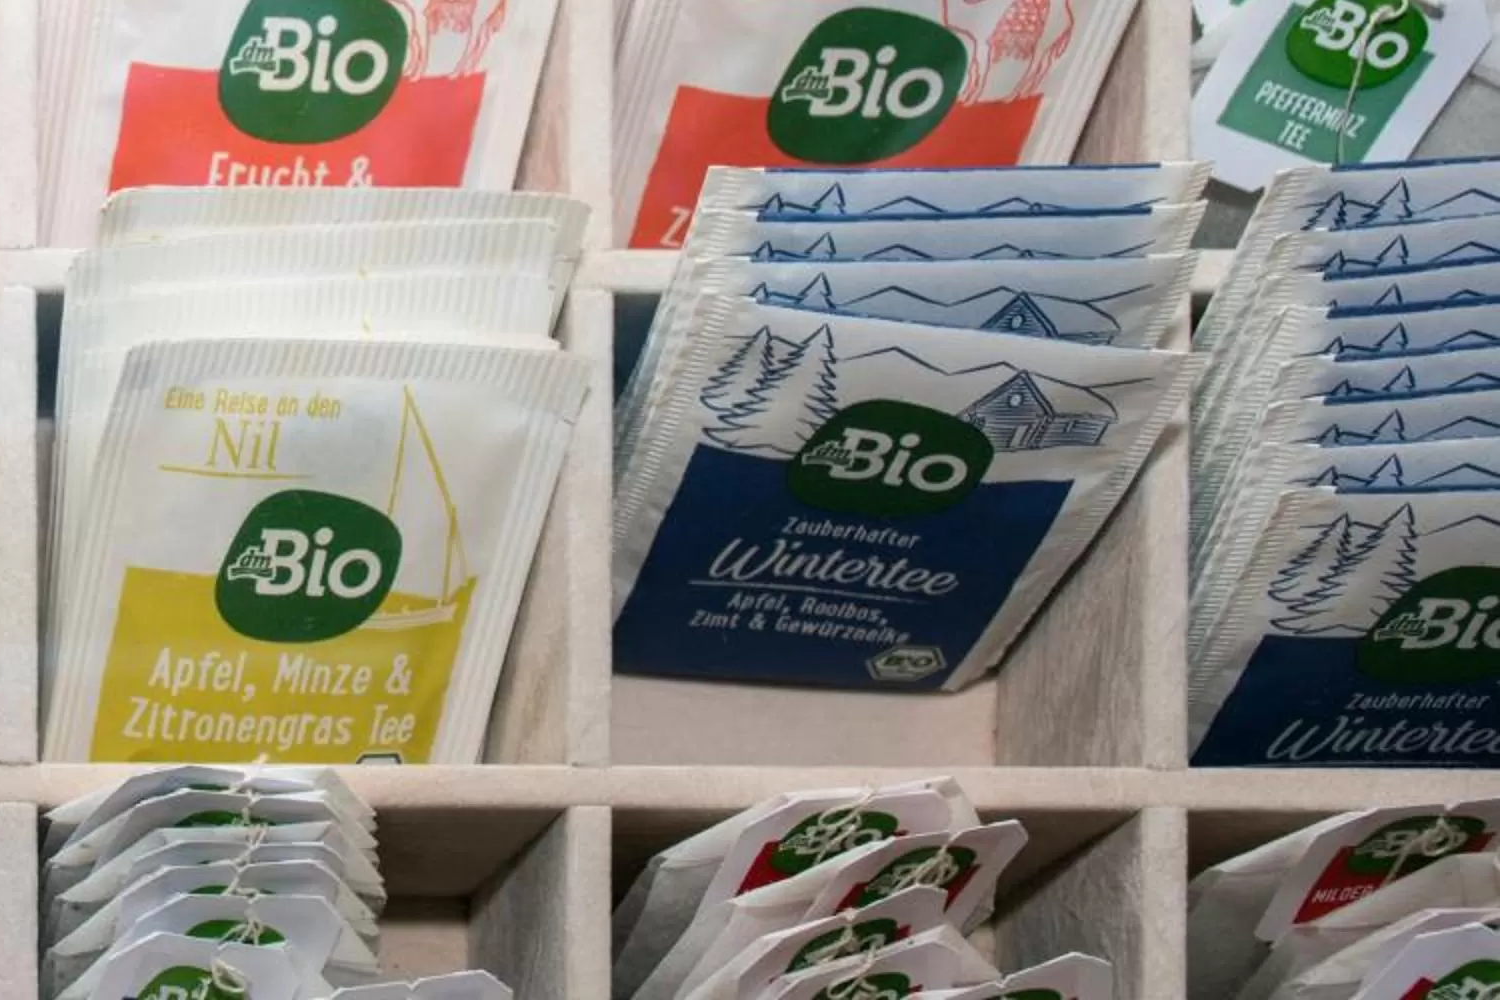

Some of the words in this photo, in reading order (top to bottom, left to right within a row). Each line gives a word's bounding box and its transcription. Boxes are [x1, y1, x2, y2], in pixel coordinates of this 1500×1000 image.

[260, 15, 389, 95] Bio
[809, 45, 943, 118] Bio
[1278, 120, 1312, 150] TEE
[207, 151, 330, 188] Frucht
[350, 155, 373, 188] &
[164, 385, 204, 411] Eine
[213, 388, 267, 415] Reise
[276, 395, 299, 416] an
[307, 397, 340, 419] den
[204, 417, 280, 472] Nil
[829, 428, 968, 492] Bio
[781, 516, 921, 549] Zauberhafter
[254, 526, 381, 598] Bio
[709, 537, 959, 595] Wintertee
[688, 610, 739, 628] Zimt
[748, 612, 764, 630] &
[727, 591, 790, 613] Apfel,
[800, 596, 889, 625] Rooibos,
[149, 647, 256, 702] Apfel,
[272, 652, 372, 696] Minze
[385, 652, 413, 696] &
[123, 696, 354, 750] Zitronengras
[368, 704, 416, 745] Tee
